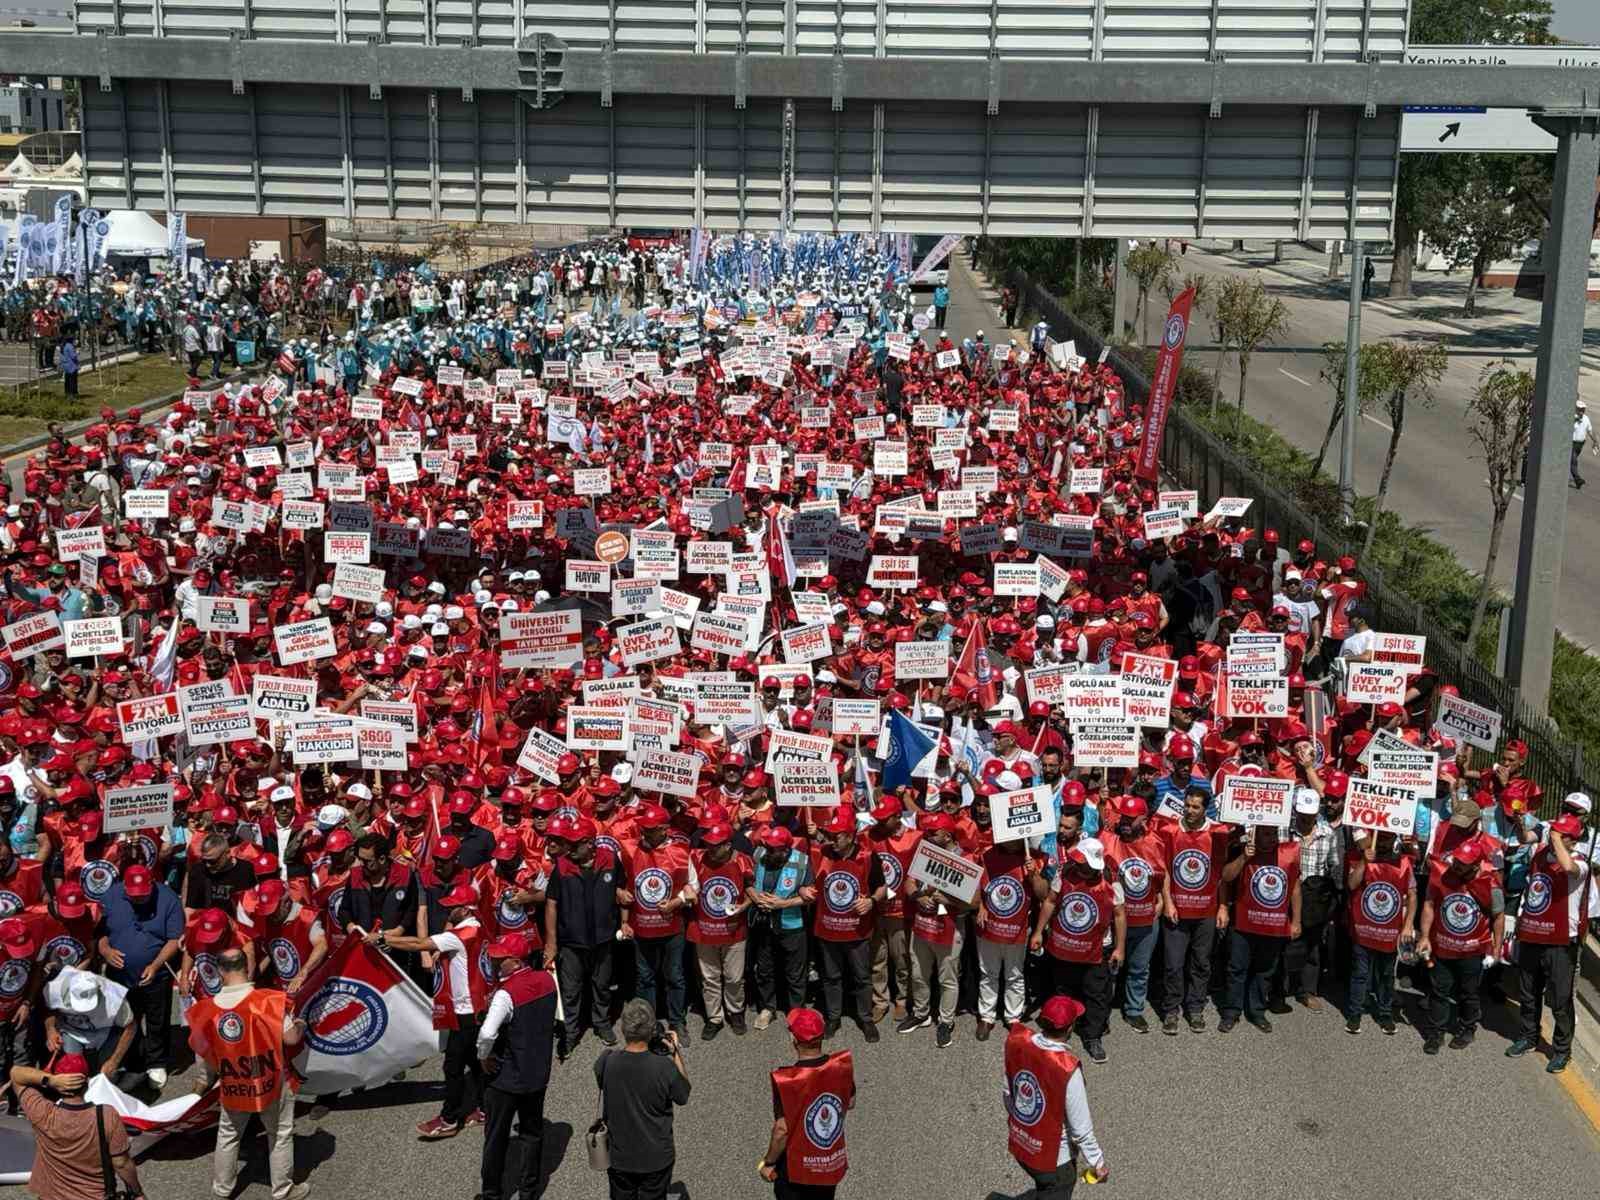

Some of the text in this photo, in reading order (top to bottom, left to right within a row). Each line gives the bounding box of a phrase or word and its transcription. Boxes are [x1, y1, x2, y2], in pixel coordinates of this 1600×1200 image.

[881, 559, 896, 569] EŞİT
[511, 613, 570, 629] ÜNİVERSİTE
[700, 616, 726, 627] GÜÇLÜ
[520, 626, 562, 636] PERSONELİ
[628, 622, 662, 636] MEMUR
[516, 638, 540, 648] TAYİN
[623, 634, 651, 647] ÜVEY
[696, 630, 743, 648] TÜRKİYE
[1384, 638, 1400, 650] EŞİT
[625, 640, 656, 655] EVLAT
[1132, 662, 1164, 679] ZAM
[1232, 664, 1275, 672] HAKKIDIR
[1360, 667, 1394, 676] MEMUR
[1070, 679, 1096, 688] GÜÇLÜ
[1231, 680, 1286, 688] TEKLİFTE
[1352, 674, 1381, 684] ÜVEY
[188, 683, 224, 696] SERVİS
[282, 682, 313, 692] REZALET
[588, 684, 616, 692] GÜÇLÜ
[1352, 684, 1384, 693] EVLAT
[1147, 690, 1165, 698] AİLE
[261, 698, 306, 711] ADALET
[588, 696, 632, 707] TÜRKİY
[1068, 696, 1120, 707] TÜRKİYE
[1232, 701, 1267, 714] YOK
[132, 705, 167, 720] ZAM
[1128, 704, 1166, 718] RKİYE
[192, 718, 249, 734] HAKKIDIR
[1446, 716, 1489, 738] ADALET
[360, 730, 392, 742] 3600
[298, 740, 352, 752] HAKKIDIR
[776, 735, 828, 752] TEKLİF REZALET
[642, 760, 692, 776] ÜCRETLERİ
[784, 766, 826, 776] EK DERS
[638, 771, 693, 786] ARTIRILSIN
[782, 776, 832, 784] ÜCRETLERİ
[781, 786, 835, 794] ARTIRILSIN
[1233, 789, 1284, 800] HER ŞEYE
[1352, 782, 1415, 800] TEKLİFTE
[110, 792, 168, 805] ENFLASYON
[1013, 795, 1030, 804] HAK
[1012, 806, 1032, 815] EMEK
[1350, 800, 1386, 811] ADALET
[1011, 815, 1039, 826] ADALET
[1350, 807, 1390, 827] YOK
[924, 860, 964, 888] HAYIR
[221, 1050, 275, 1080] ASIN
